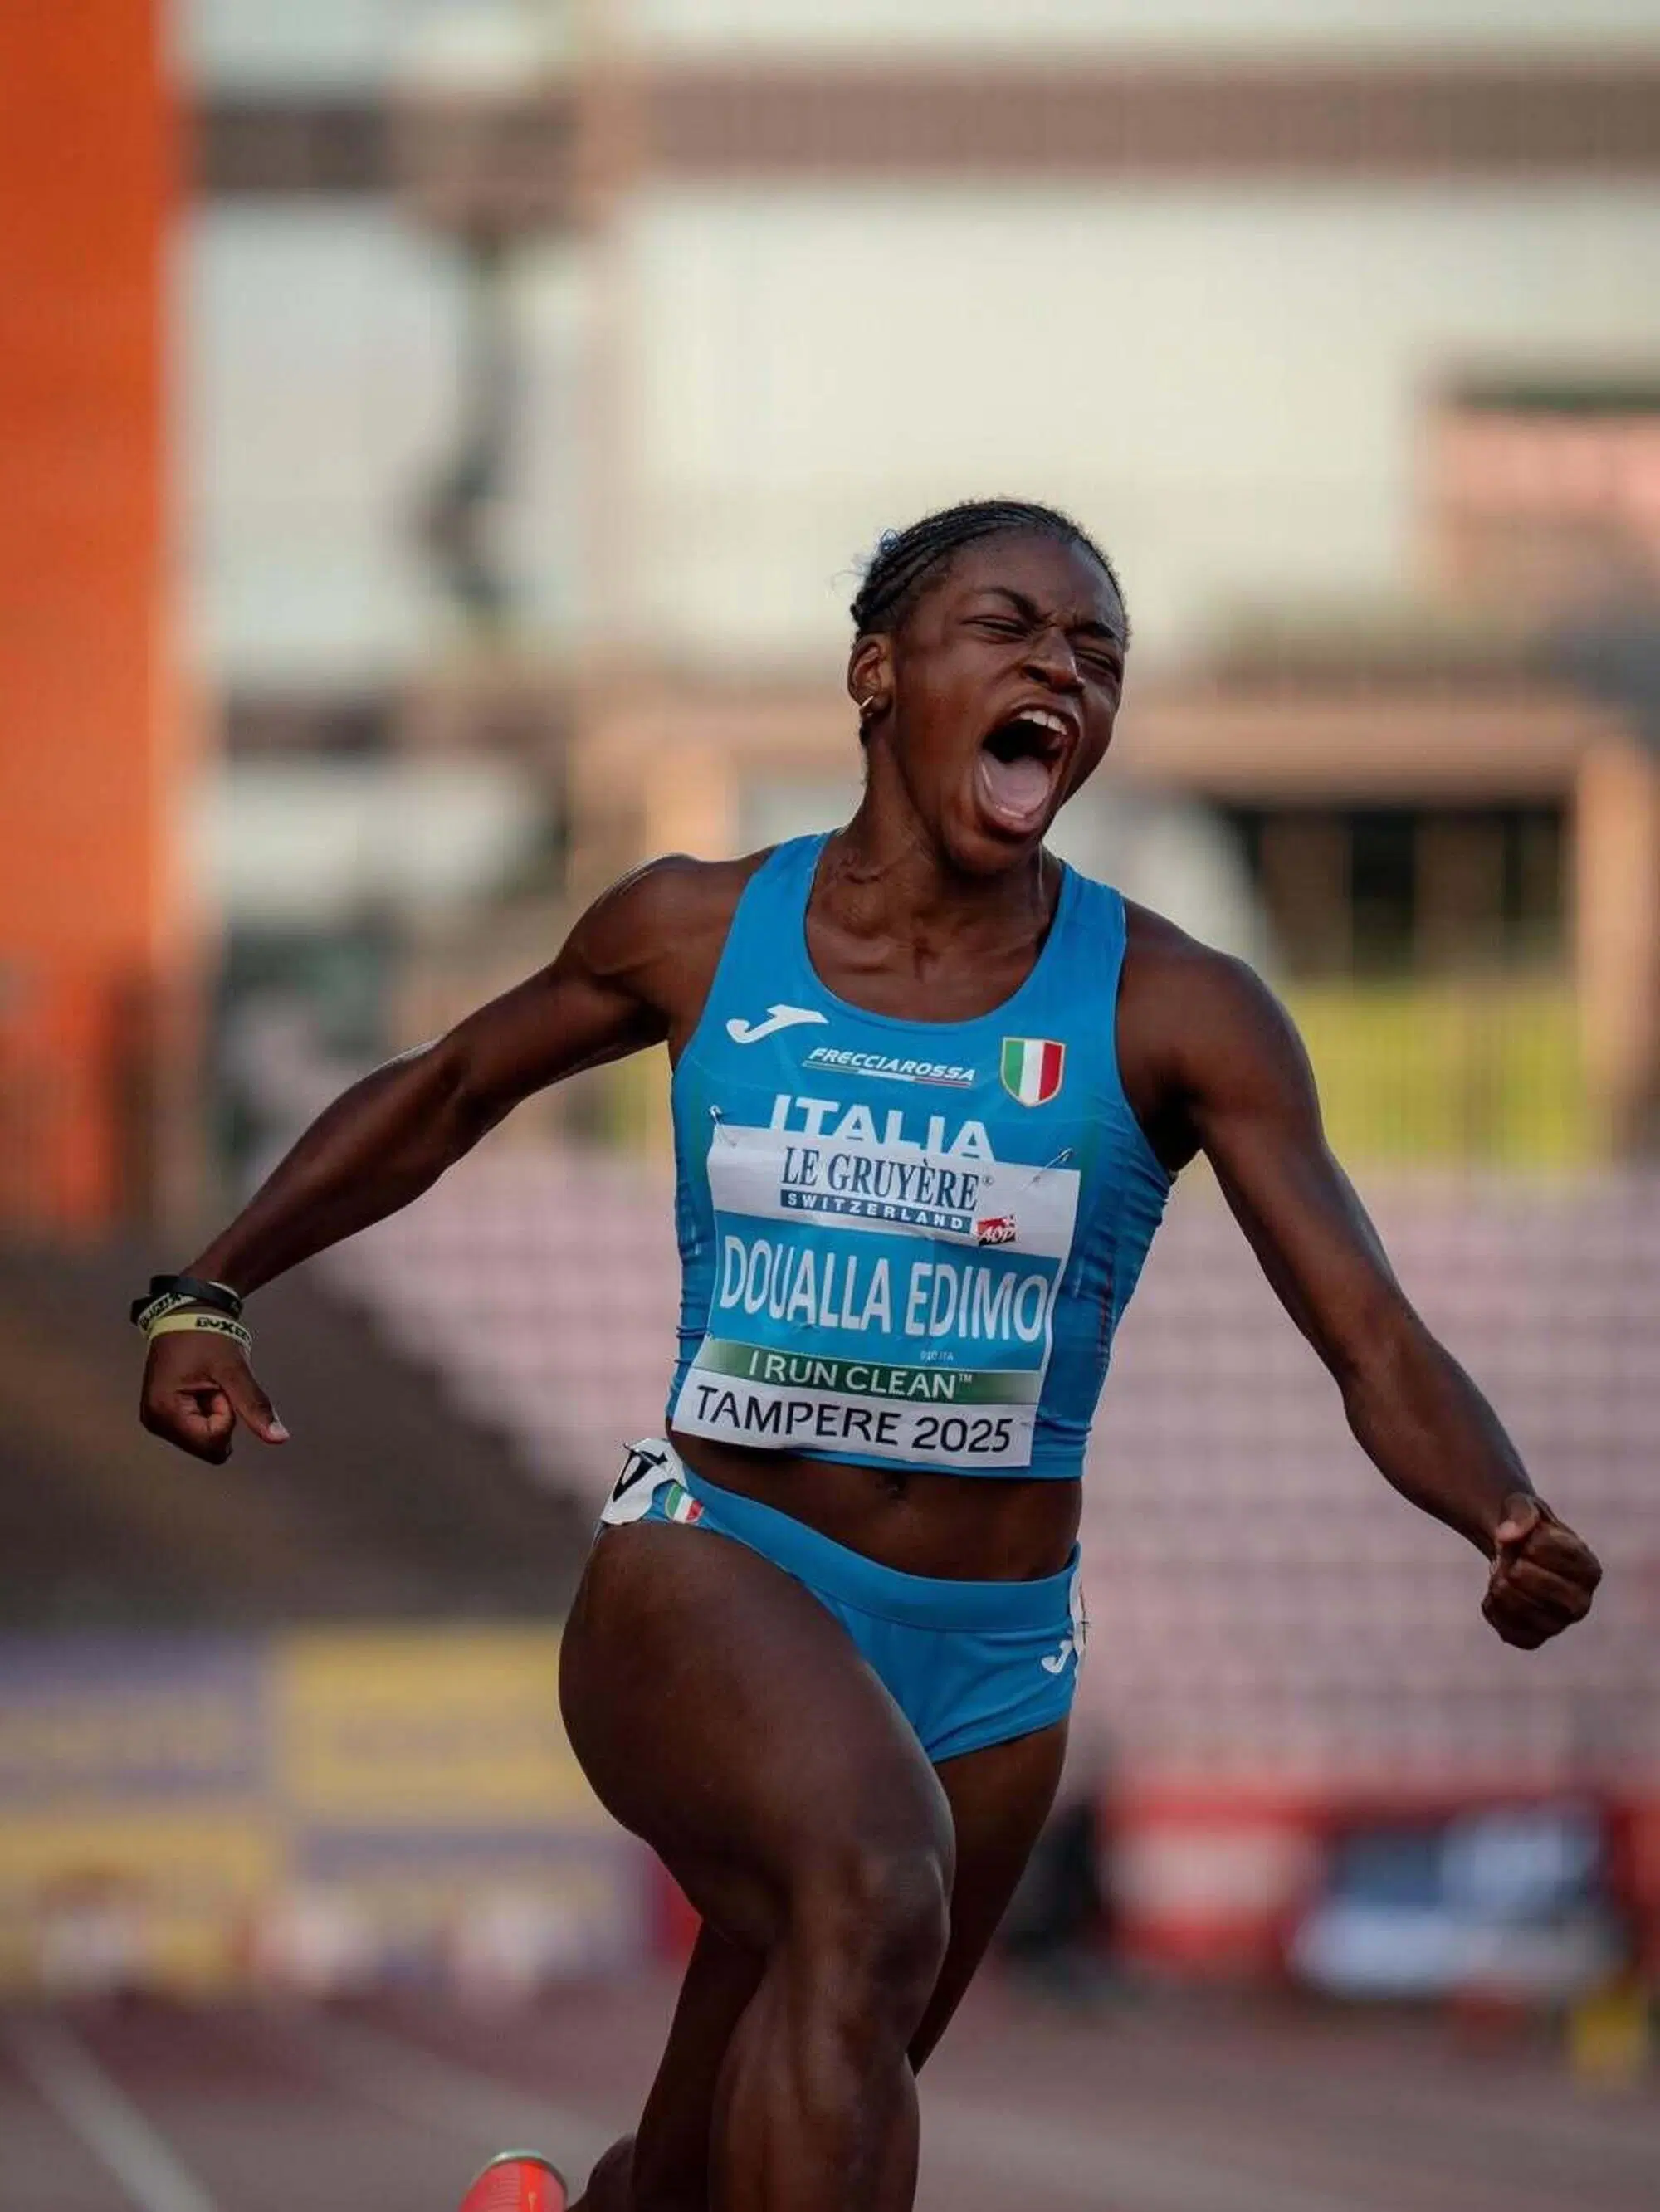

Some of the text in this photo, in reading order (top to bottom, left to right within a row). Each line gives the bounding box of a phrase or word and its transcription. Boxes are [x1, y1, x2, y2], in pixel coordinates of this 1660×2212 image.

[808, 1047, 976, 1081] FRECCIAROSSA
[769, 1094, 996, 1161] ITALIA
[781, 1145, 820, 1187] LE
[788, 1192, 963, 1230] SWITZERLAND
[720, 1235, 1048, 1342] DOUALLA EDIMO
[749, 1350, 759, 1376] I
[766, 1353, 837, 1387] RUN
[696, 1385, 1013, 1453] TAMPERE 2025
